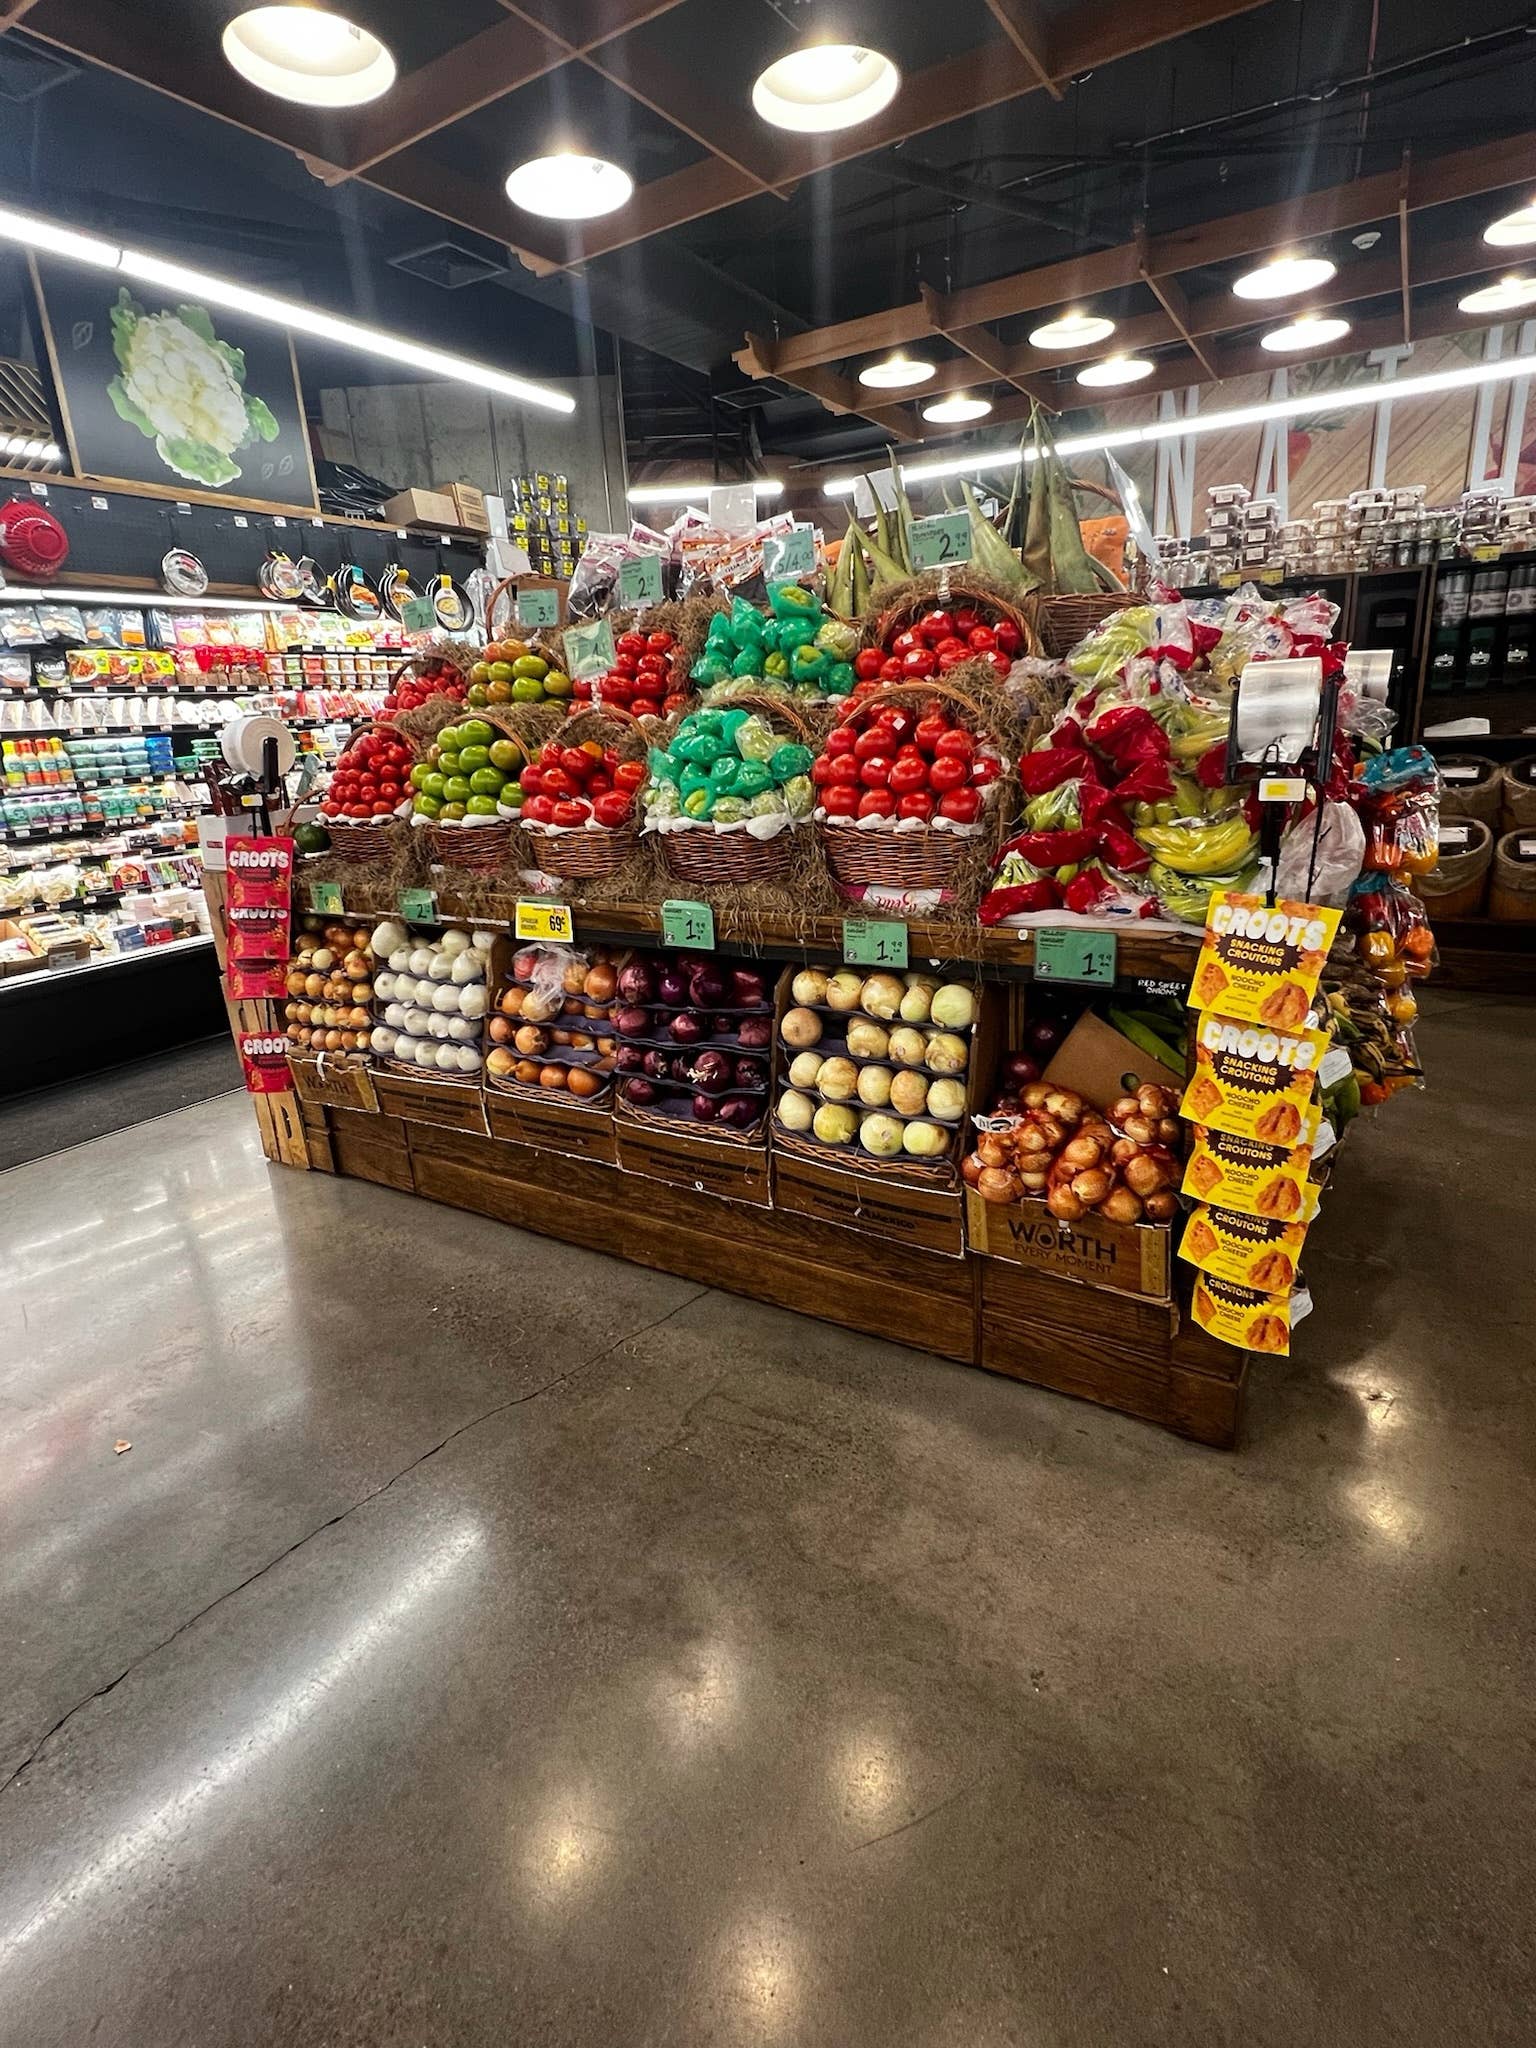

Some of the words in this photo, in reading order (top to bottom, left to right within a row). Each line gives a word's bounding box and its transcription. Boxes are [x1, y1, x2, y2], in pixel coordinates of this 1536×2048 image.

[229, 851, 289, 868] CROOTS
[1212, 904, 1328, 951] CROOTS
[1227, 948, 1283, 967] CROUTONS
[1230, 938, 1285, 957] SNACKING
[1158, 982, 1187, 990] SWEET
[243, 1037, 291, 1055] CROOT
[1203, 1020, 1316, 1070] CROOTS
[1220, 1065, 1277, 1086] CROUTONS
[1222, 1056, 1278, 1076] SNACKING
[1217, 1142, 1273, 1161] CROUTONS
[1214, 1212, 1268, 1236] CROUTONS
[1008, 1218, 1117, 1264] WORTH
[1013, 1244, 1050, 1260] EVERY
[1055, 1253, 1112, 1274] MOMENT
[1208, 1278, 1255, 1299] CROUTONS
